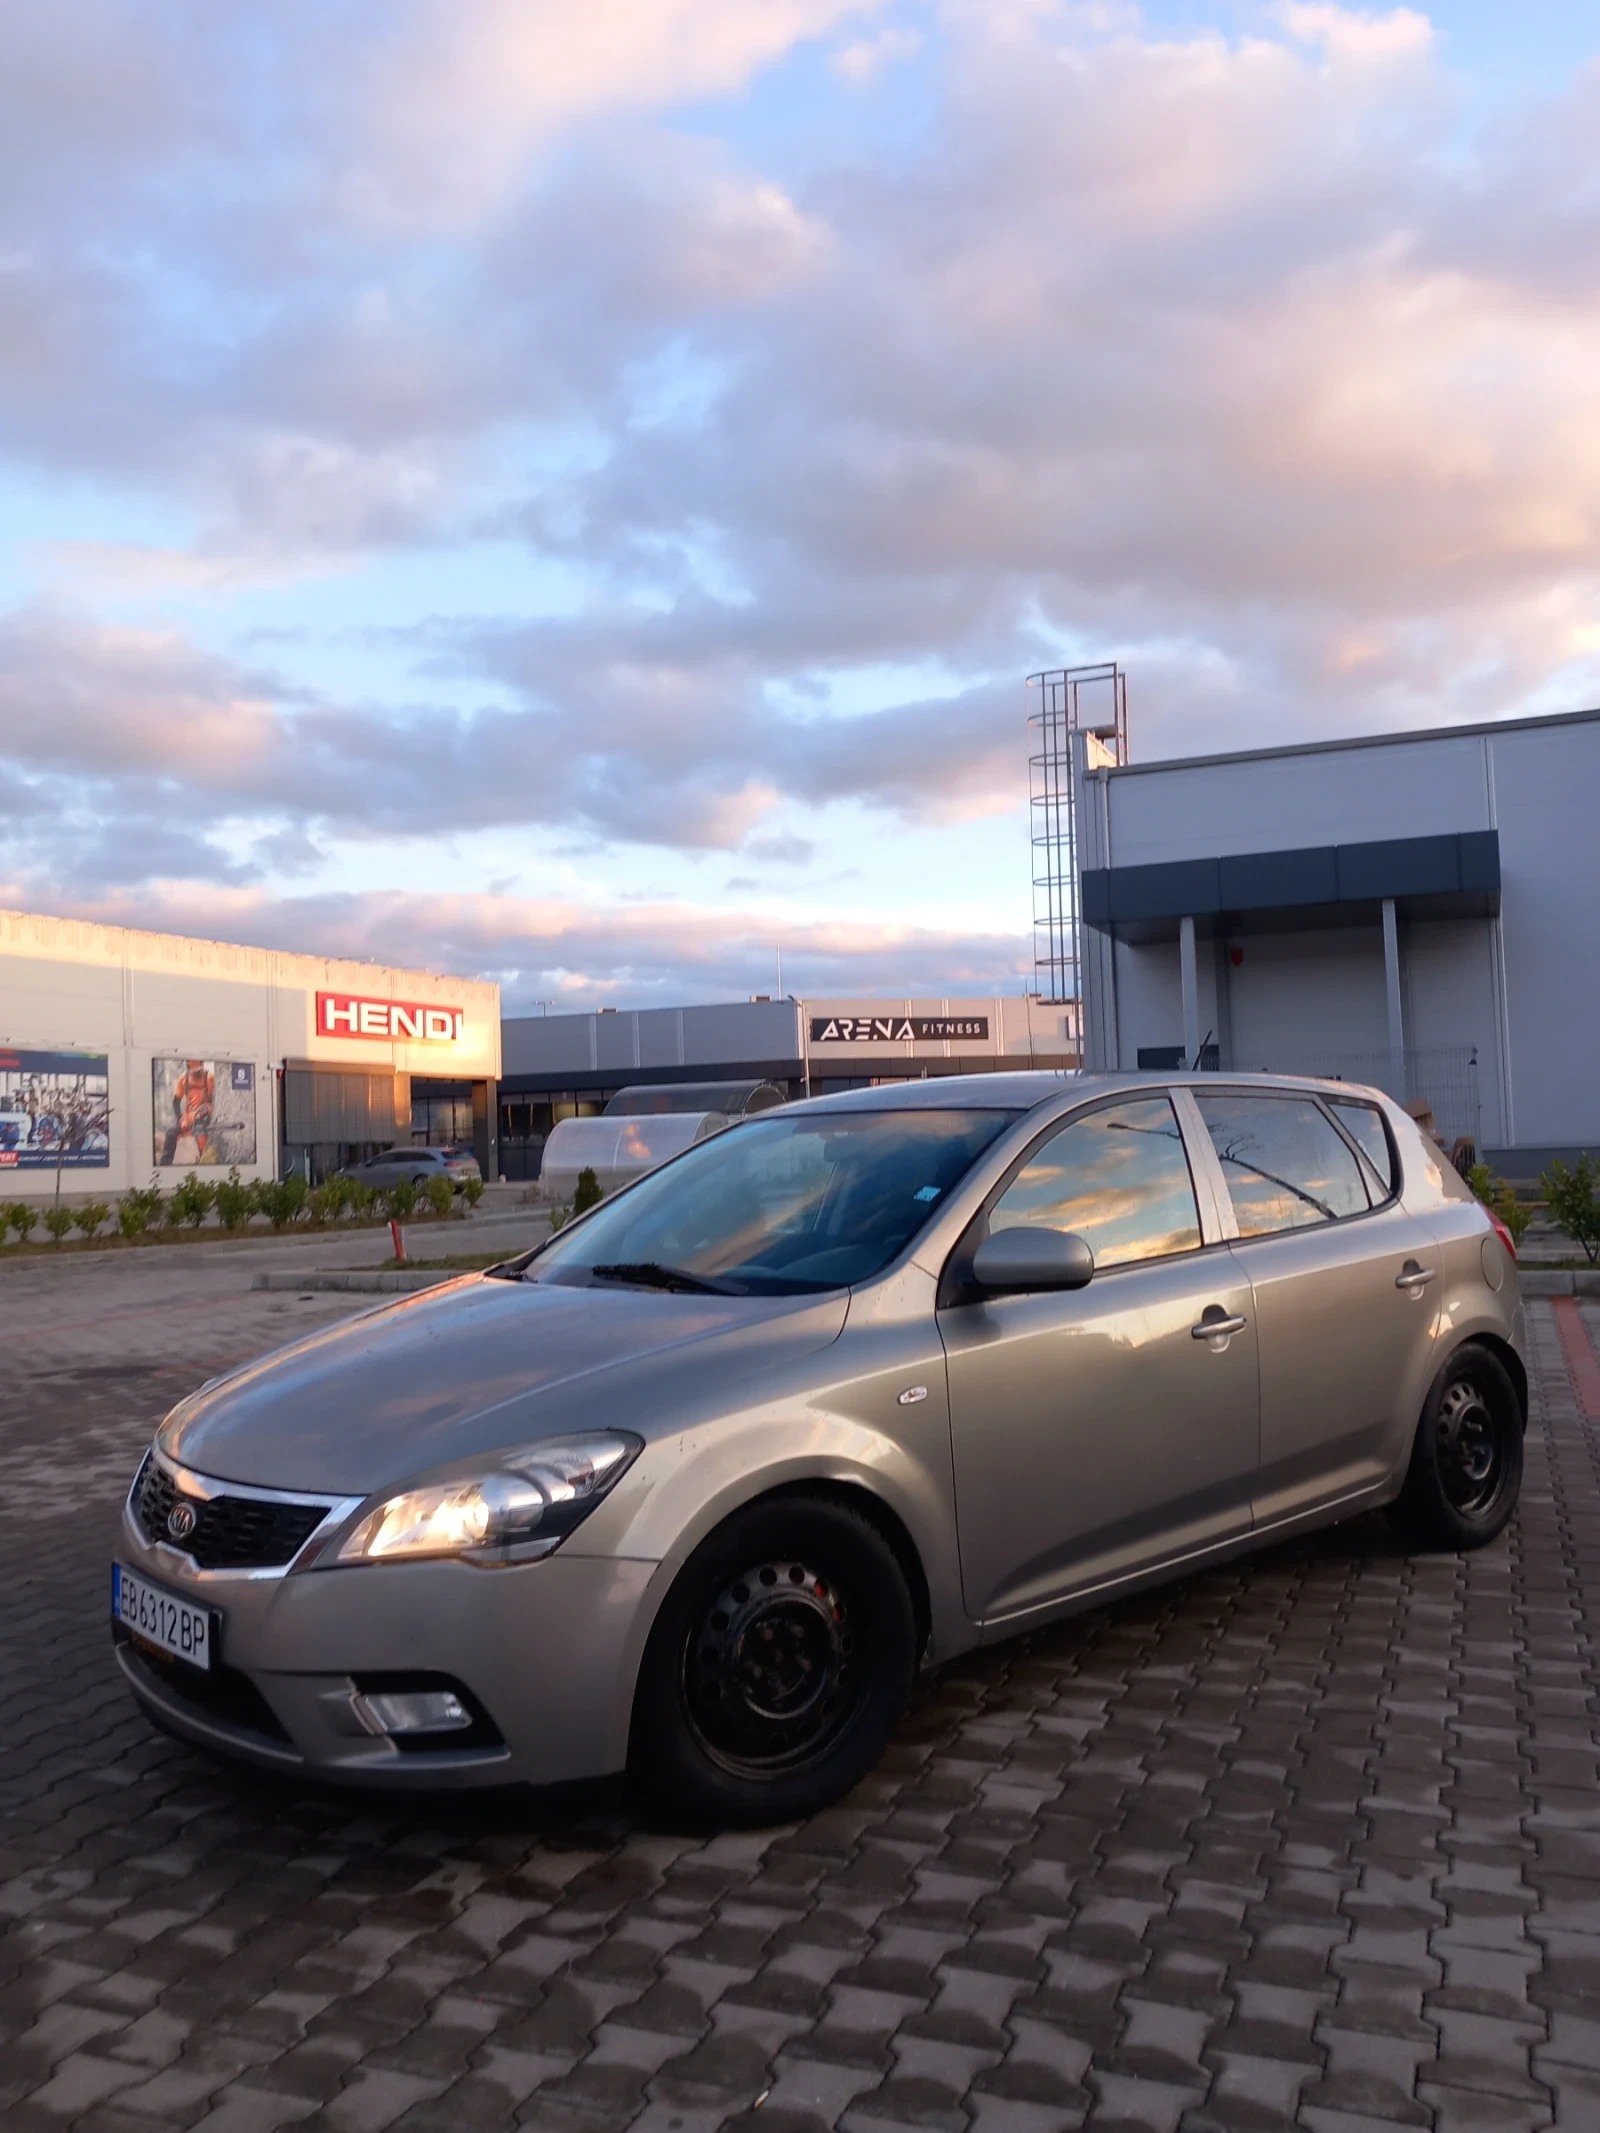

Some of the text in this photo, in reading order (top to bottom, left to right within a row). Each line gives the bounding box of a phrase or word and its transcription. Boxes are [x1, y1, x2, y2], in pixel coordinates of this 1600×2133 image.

[326, 998, 464, 1041] HENDI
[820, 1018, 980, 1040] ARENA FITNESS
